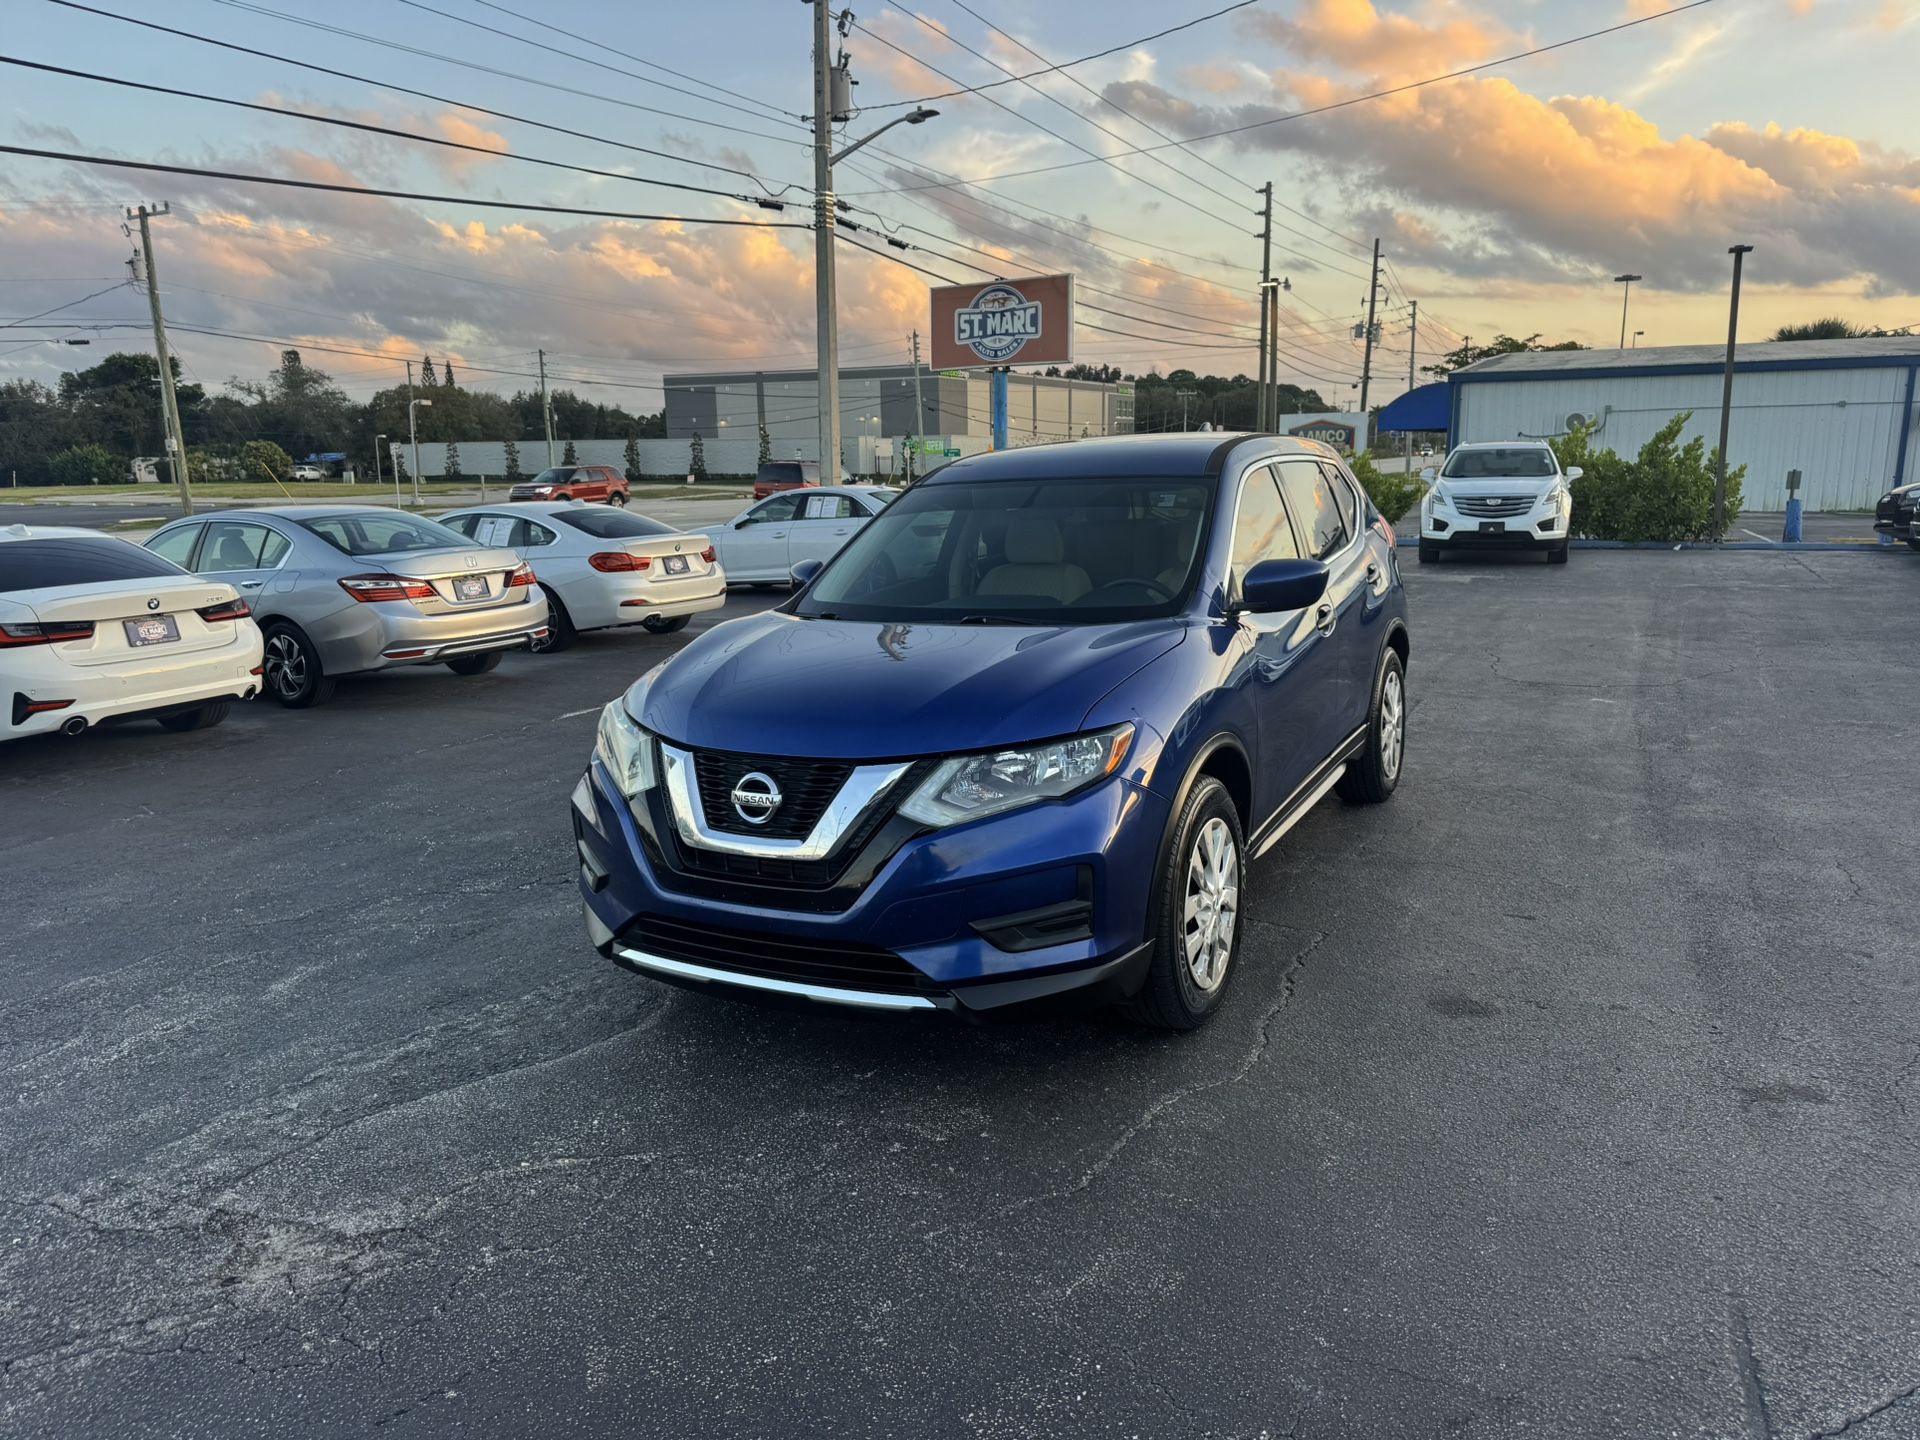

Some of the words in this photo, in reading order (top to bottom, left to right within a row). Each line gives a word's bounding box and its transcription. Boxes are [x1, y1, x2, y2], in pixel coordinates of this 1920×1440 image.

[959, 314, 983, 340] ST.
[986, 307, 1037, 335] MARC
[977, 344, 995, 357] AUTO
[997, 341, 1018, 357] SALES
[1298, 429, 1346, 442] AAMCO
[734, 793, 774, 805] NISSAN
